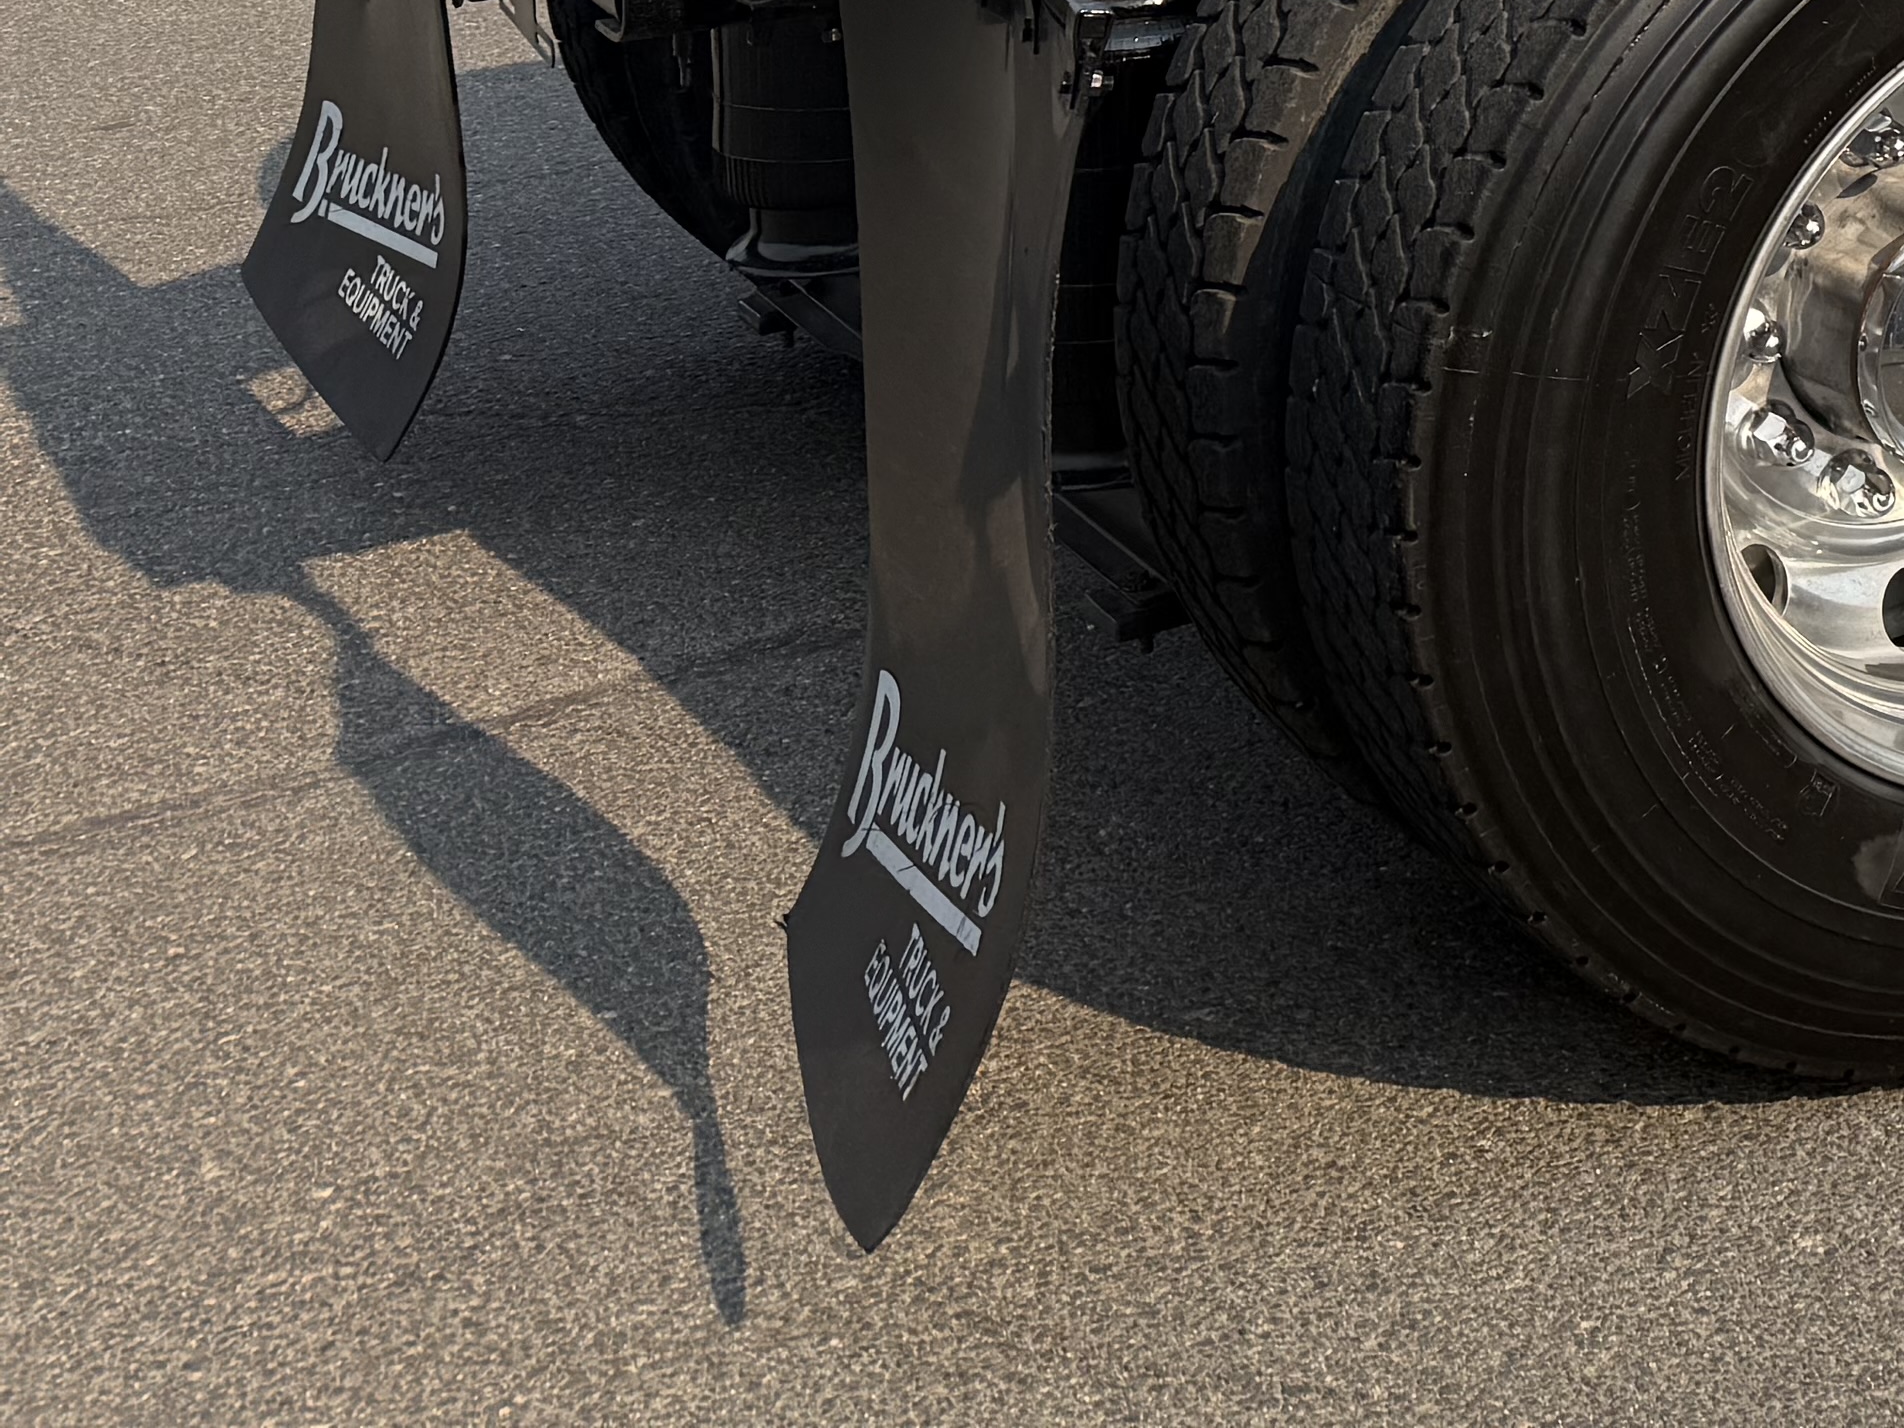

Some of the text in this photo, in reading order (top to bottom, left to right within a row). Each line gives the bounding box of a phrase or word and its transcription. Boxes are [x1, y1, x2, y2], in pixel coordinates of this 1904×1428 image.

[290, 100, 445, 245] Bruckner's
[337, 268, 414, 361] EQUIPMENT
[369, 254, 424, 332] TRUCK &
[841, 668, 1007, 918] Bruckner's
[864, 938, 929, 1102] EQUIPMENT
[899, 921, 952, 1057] TRUCK &
